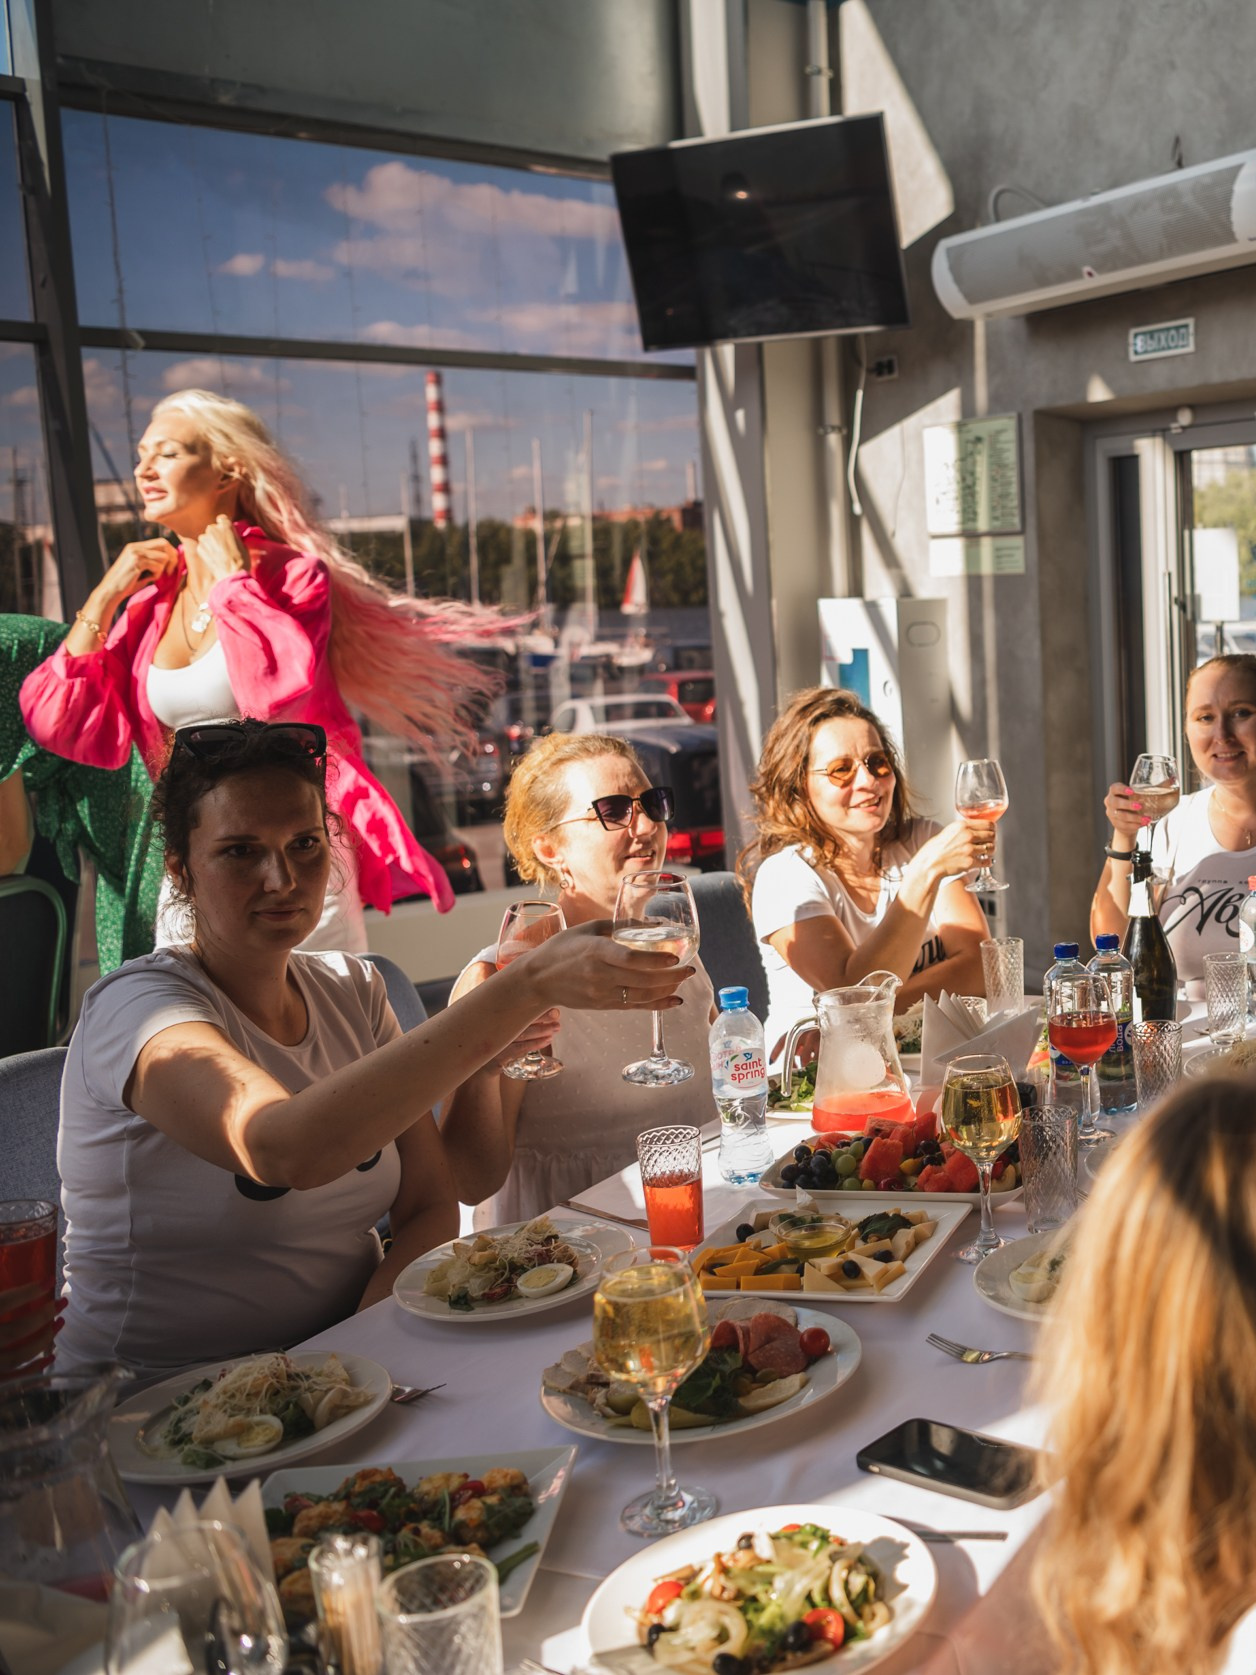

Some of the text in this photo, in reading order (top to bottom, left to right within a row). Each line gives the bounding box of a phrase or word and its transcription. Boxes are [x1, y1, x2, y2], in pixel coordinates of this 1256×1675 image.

[1135, 328, 1187, 353] ВЫХОД
[734, 1057, 762, 1071] saint
[731, 1067, 764, 1083] spring
